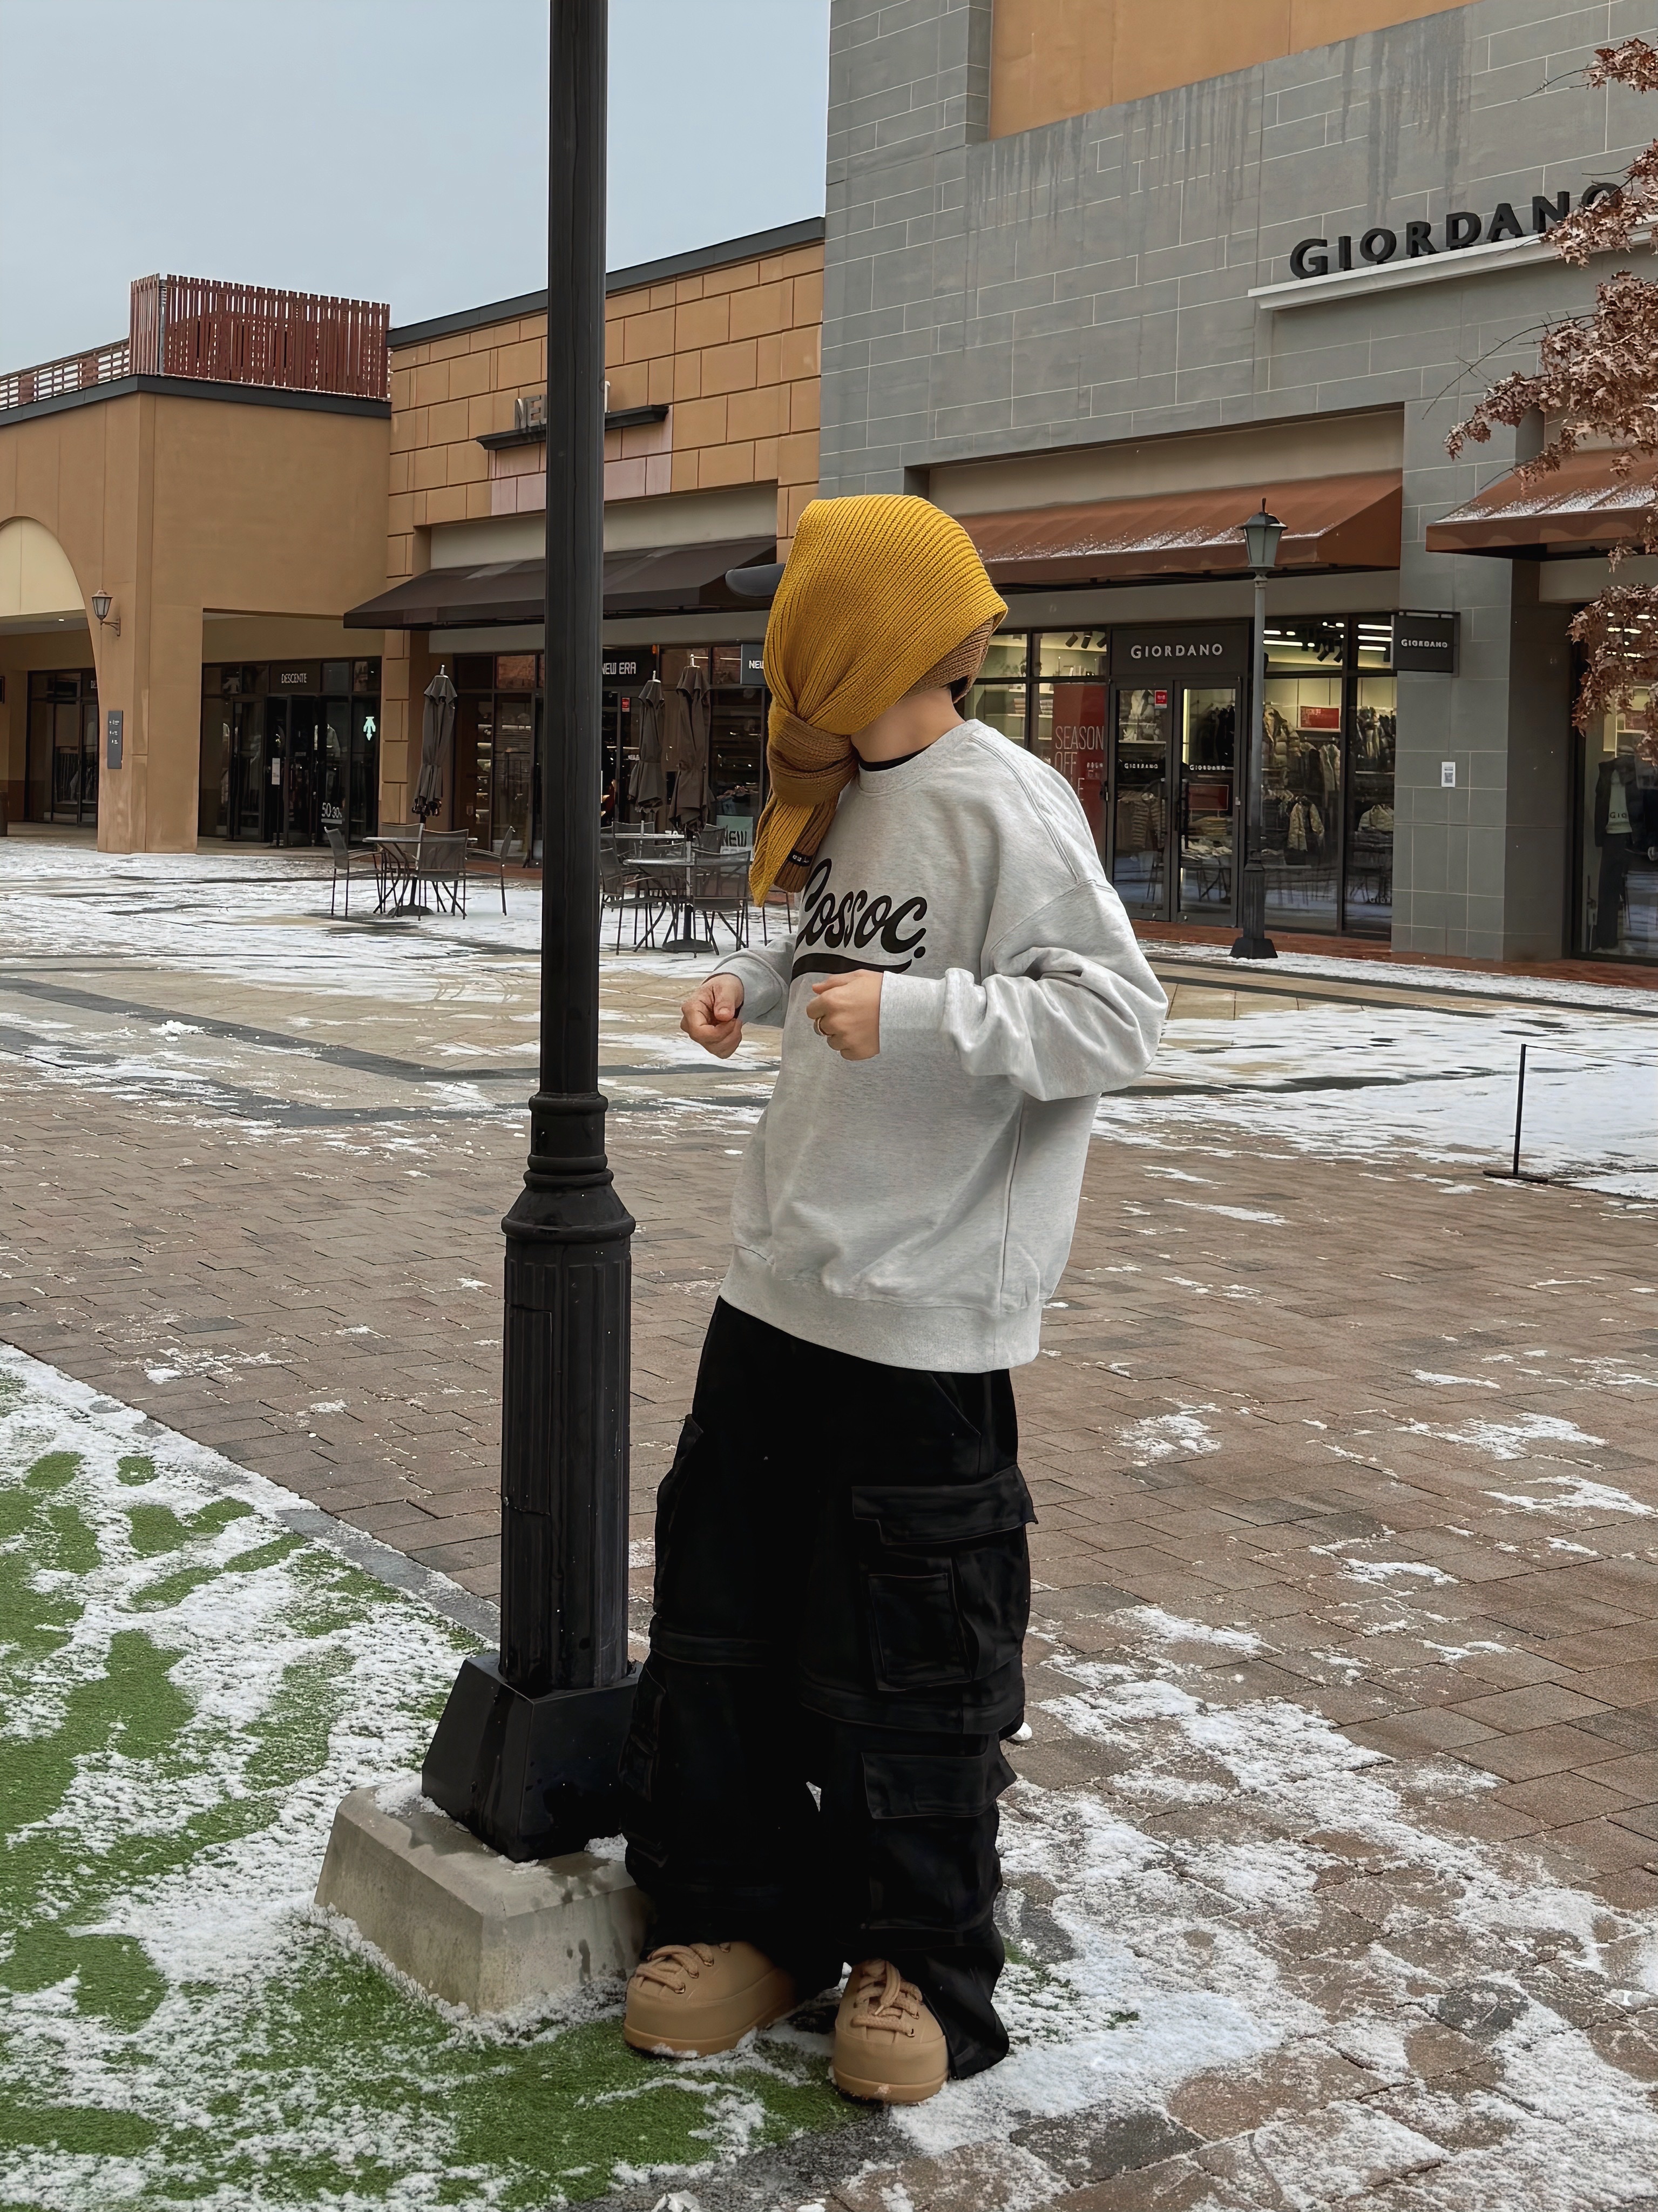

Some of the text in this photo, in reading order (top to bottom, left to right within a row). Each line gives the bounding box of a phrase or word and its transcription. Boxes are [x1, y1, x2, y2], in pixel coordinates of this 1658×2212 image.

[1400, 639, 1447, 648] GIORDANO
[1131, 644, 1222, 658] GIORDANO
[619, 662, 636, 674] ERA
[1055, 726, 1104, 750] SEASON
[1055, 751, 1078, 775] OFF
